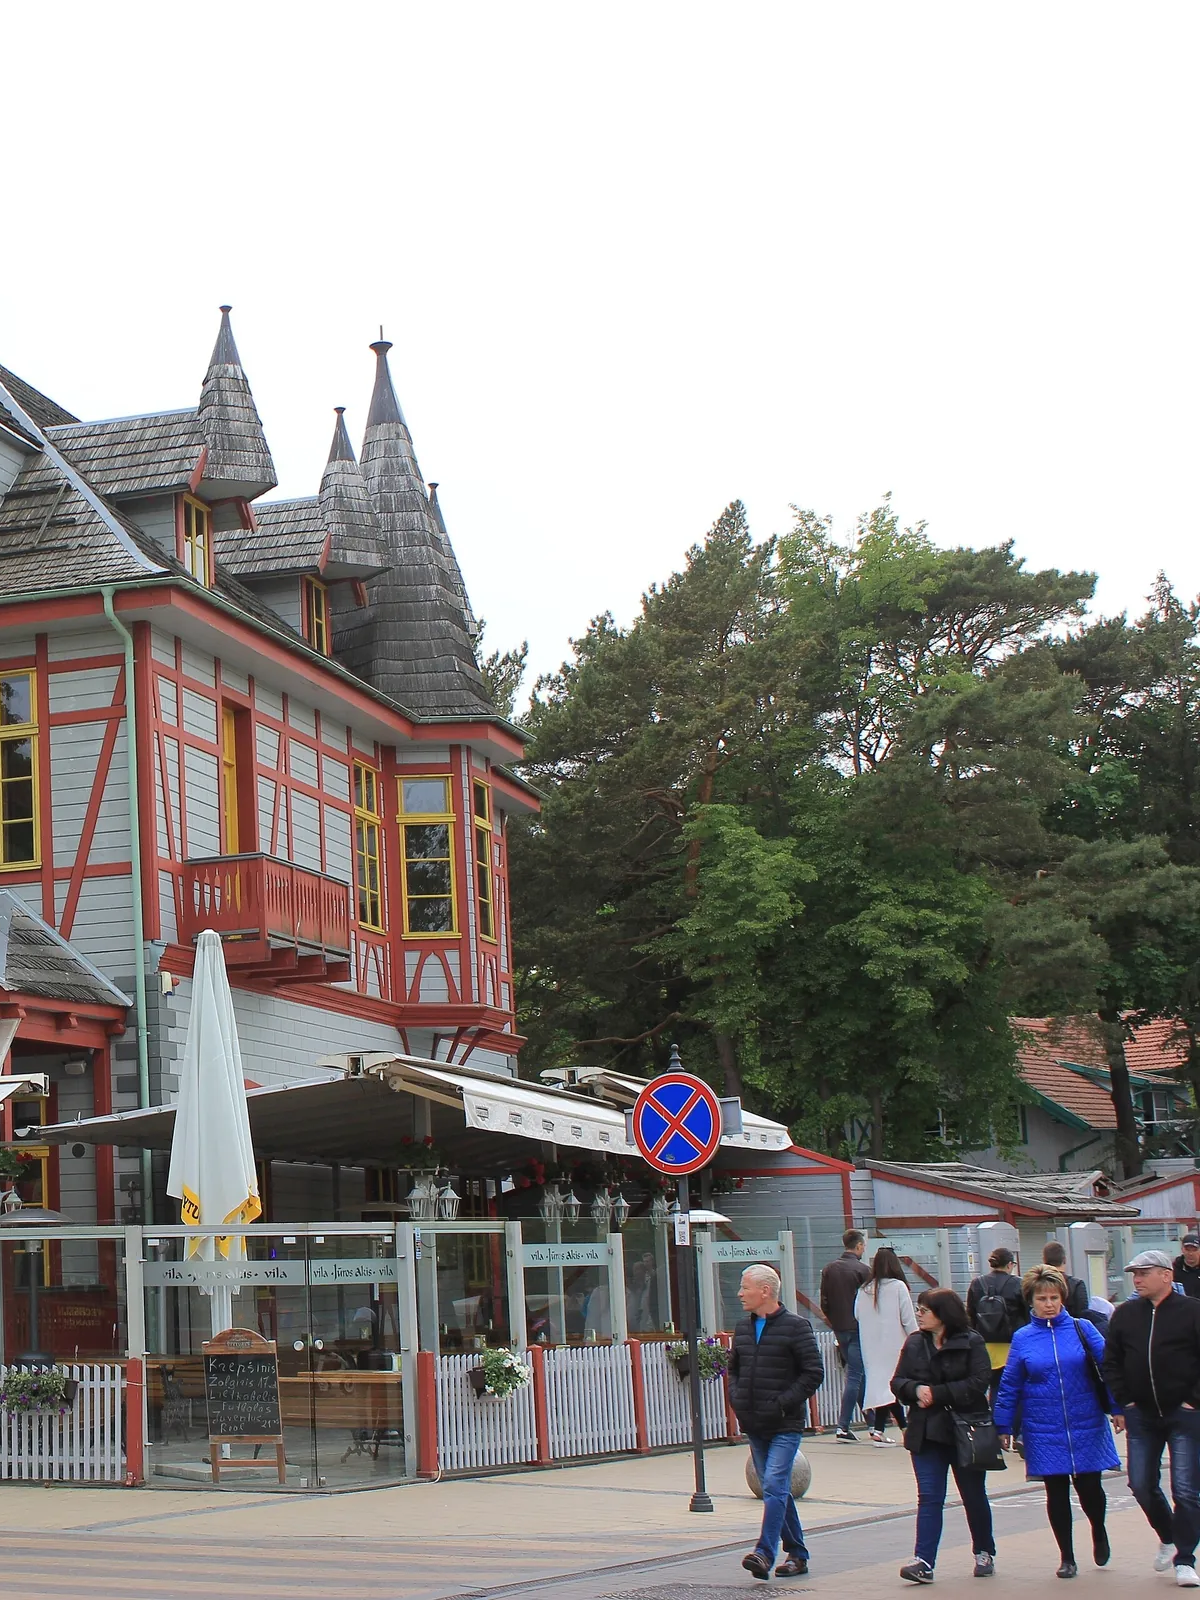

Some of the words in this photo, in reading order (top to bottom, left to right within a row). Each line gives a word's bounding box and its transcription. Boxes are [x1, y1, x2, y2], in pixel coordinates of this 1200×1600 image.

[264, 1266, 288, 1279] vila
[313, 1266, 329, 1278] vila
[378, 1264, 394, 1276] vila
[209, 1357, 276, 1377] Krepšinis
